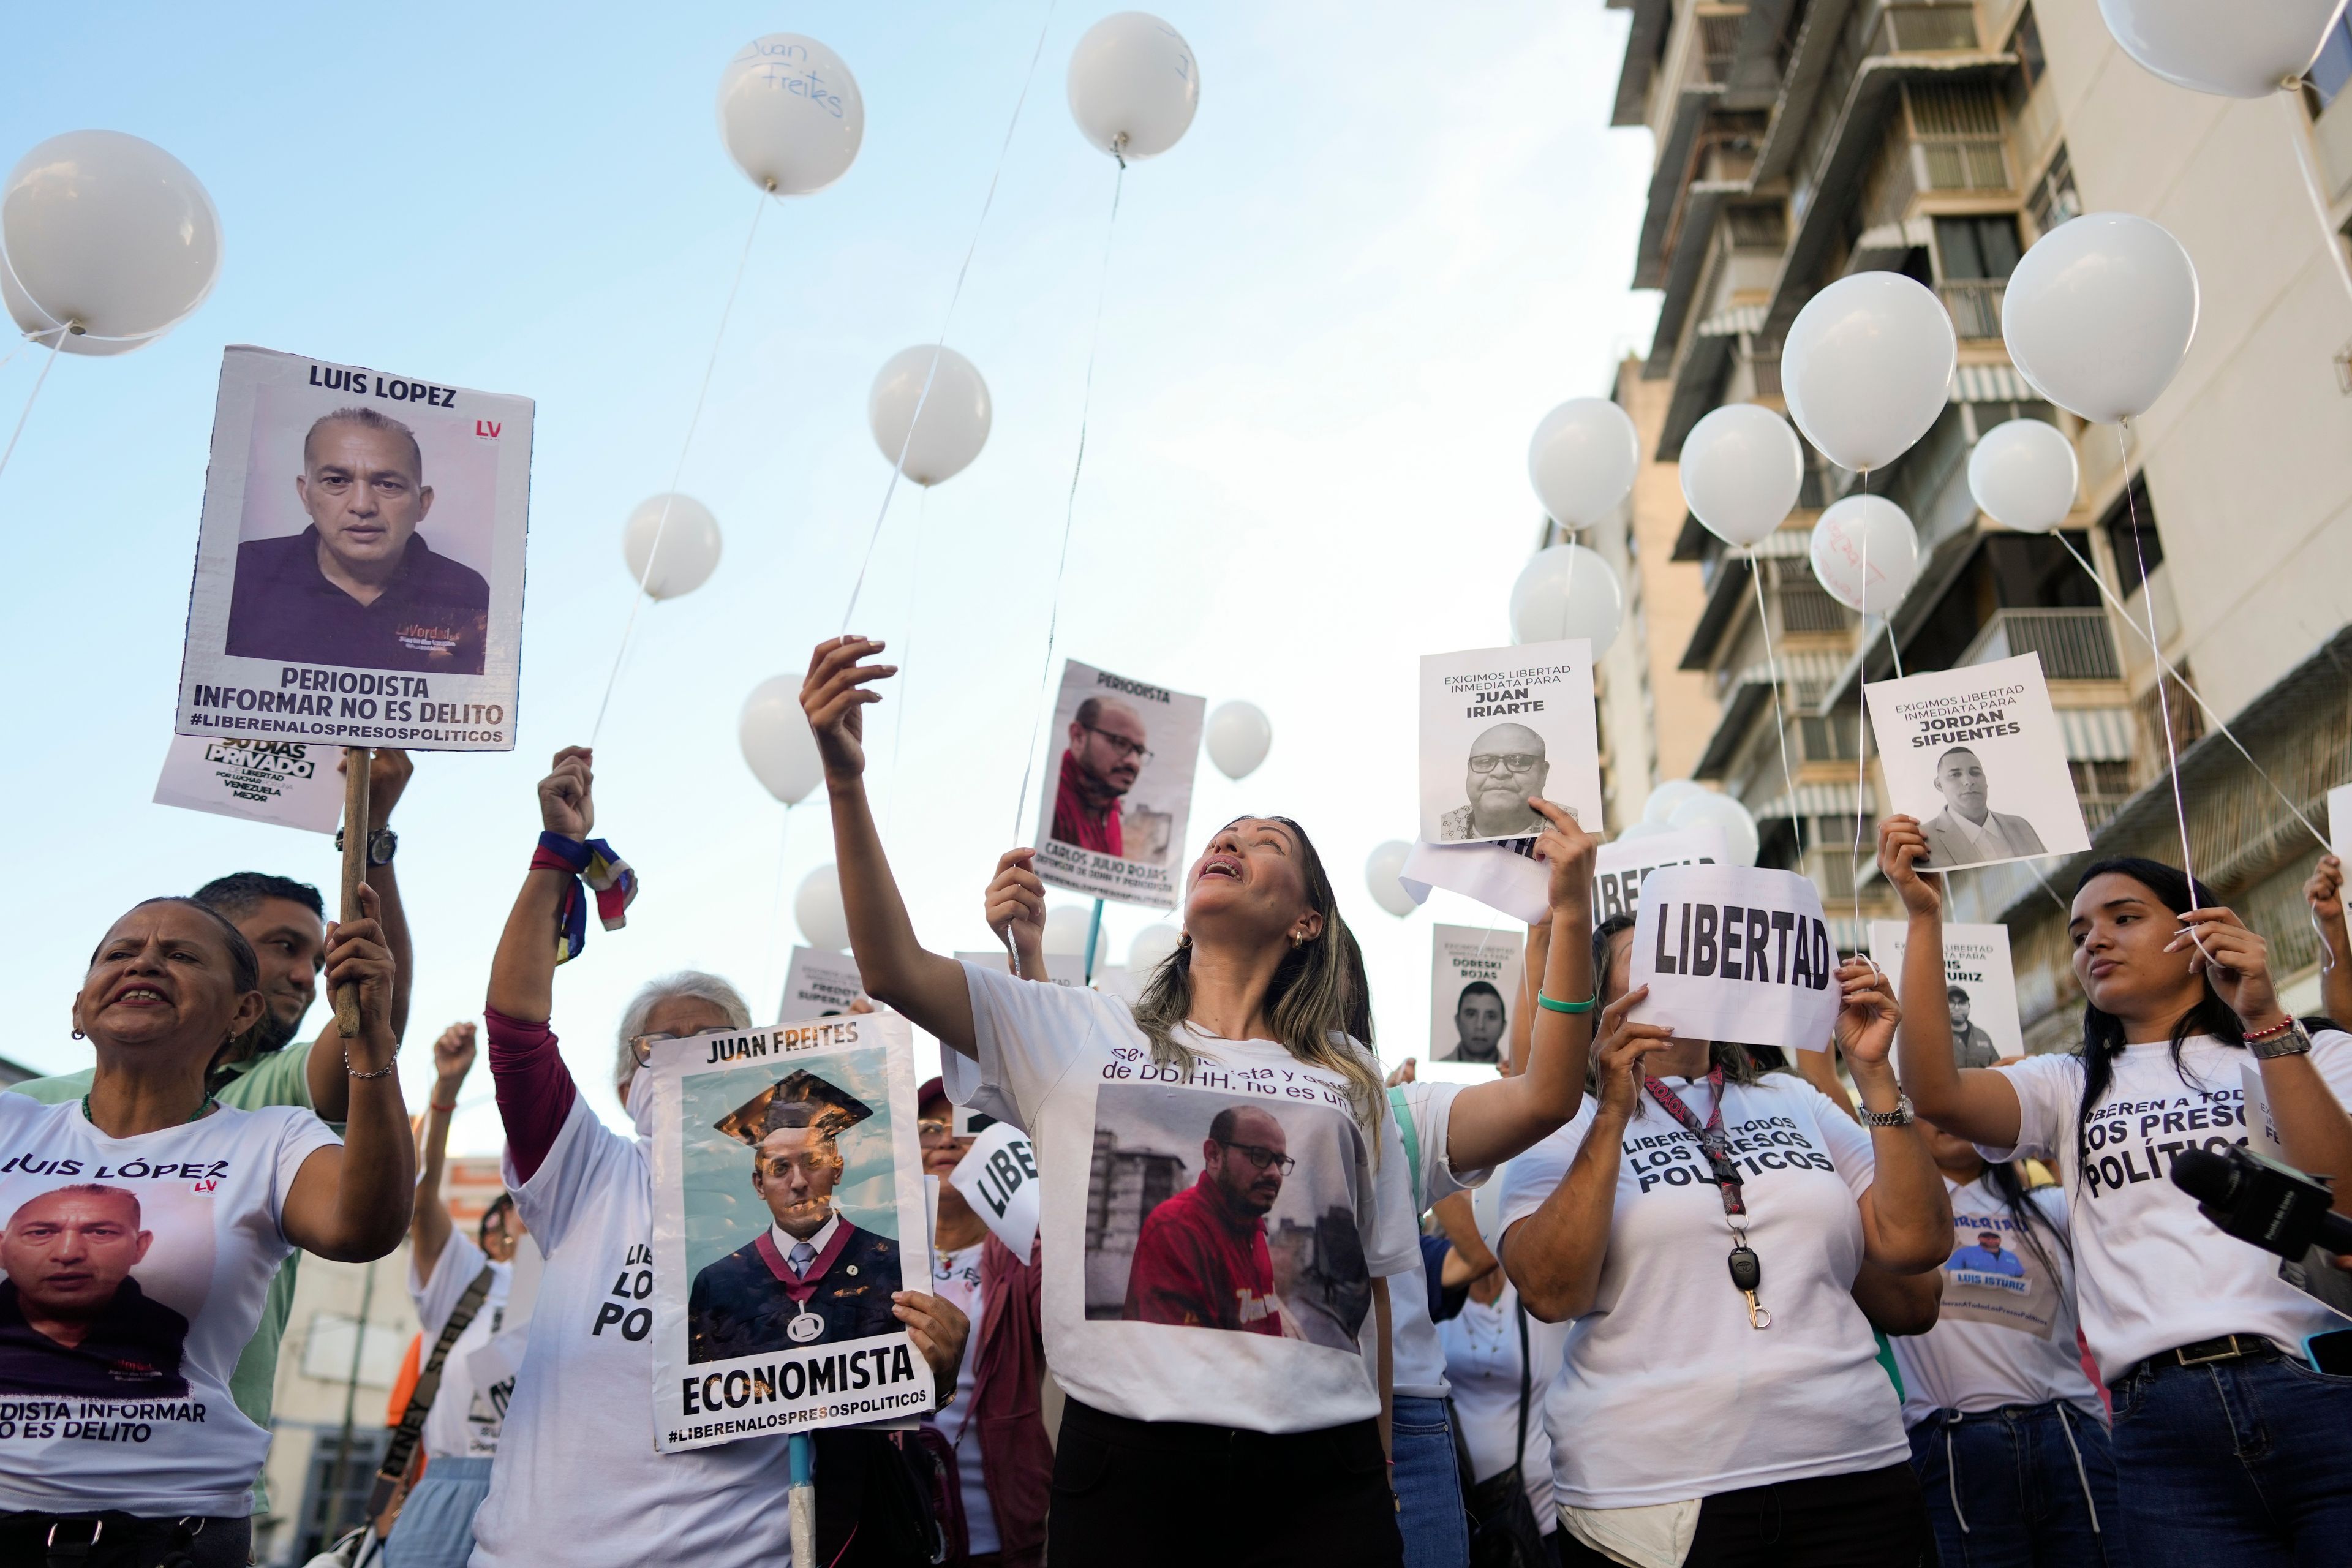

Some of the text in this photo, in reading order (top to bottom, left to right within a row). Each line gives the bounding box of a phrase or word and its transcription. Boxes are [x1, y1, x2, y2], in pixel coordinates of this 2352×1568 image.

[733, 40, 807, 63] Juan
[748, 62, 843, 118] Freites
[308, 364, 456, 409] LUIS LOPEZ
[476, 420, 501, 438] LV
[280, 666, 429, 698] PERIODISTA
[1097, 672, 1171, 704] PERIODISTA
[1444, 665, 1571, 685] EXIGIMOS LIBERTAD
[1451, 676, 1561, 693] INMEDIATA PARA
[192, 684, 503, 725] INFORMAR NO ES DELITO
[1467, 700, 1545, 718] IRIARTE
[1475, 688, 1528, 704] JUAN
[1895, 684, 2024, 714] EXIGIMOS LIBERTAD
[1904, 696, 2017, 722] INMEDIATA PARA
[190, 712, 503, 743] #LIBERENALOSPRESOSPOLITICOS
[1920, 709, 2005, 733] JORDAN
[1912, 722, 2021, 748] SIFUENTES
[208, 744, 312, 778] PRIVADO
[224, 780, 281, 796] VENEZUELA
[232, 774, 262, 784] LUCHAR
[242, 768, 284, 782] LIBERTAD
[233, 790, 268, 802] MEJOR
[1045, 842, 1167, 881] CARLOS JULIO ROJAS
[1654, 903, 1830, 991] LIBERTAD
[812, 982, 859, 997] FREDDY
[706, 1021, 859, 1064] JUAN FREITES
[1102, 1061, 1132, 1079] de
[1248, 1081, 1277, 1095] no
[1286, 1087, 1316, 1100] es
[1324, 1091, 1348, 1112] un
[1281, 1070, 1294, 1082] y
[2084, 1100, 2166, 1123] IBEREN
[2174, 1098, 2190, 1109] A
[1730, 1117, 1797, 1136] TODOS
[1630, 1131, 1813, 1175] LOS RESOS
[1, 1153, 229, 1180] LUIS LÓPEZ
[194, 1179, 217, 1192] LV
[977, 1141, 1039, 1220] LIBE
[1958, 1273, 2026, 1292] LUIS ISTURIZ
[592, 1302, 652, 1343] PO
[682, 1344, 914, 1417] ECONOMISTA
[80, 1403, 206, 1422] INFORMAR
[668, 1389, 926, 1444] #LIBERENALOSPRESOSPOLITICOS
[23, 1422, 56, 1439] ES
[62, 1422, 152, 1442] DELITO
